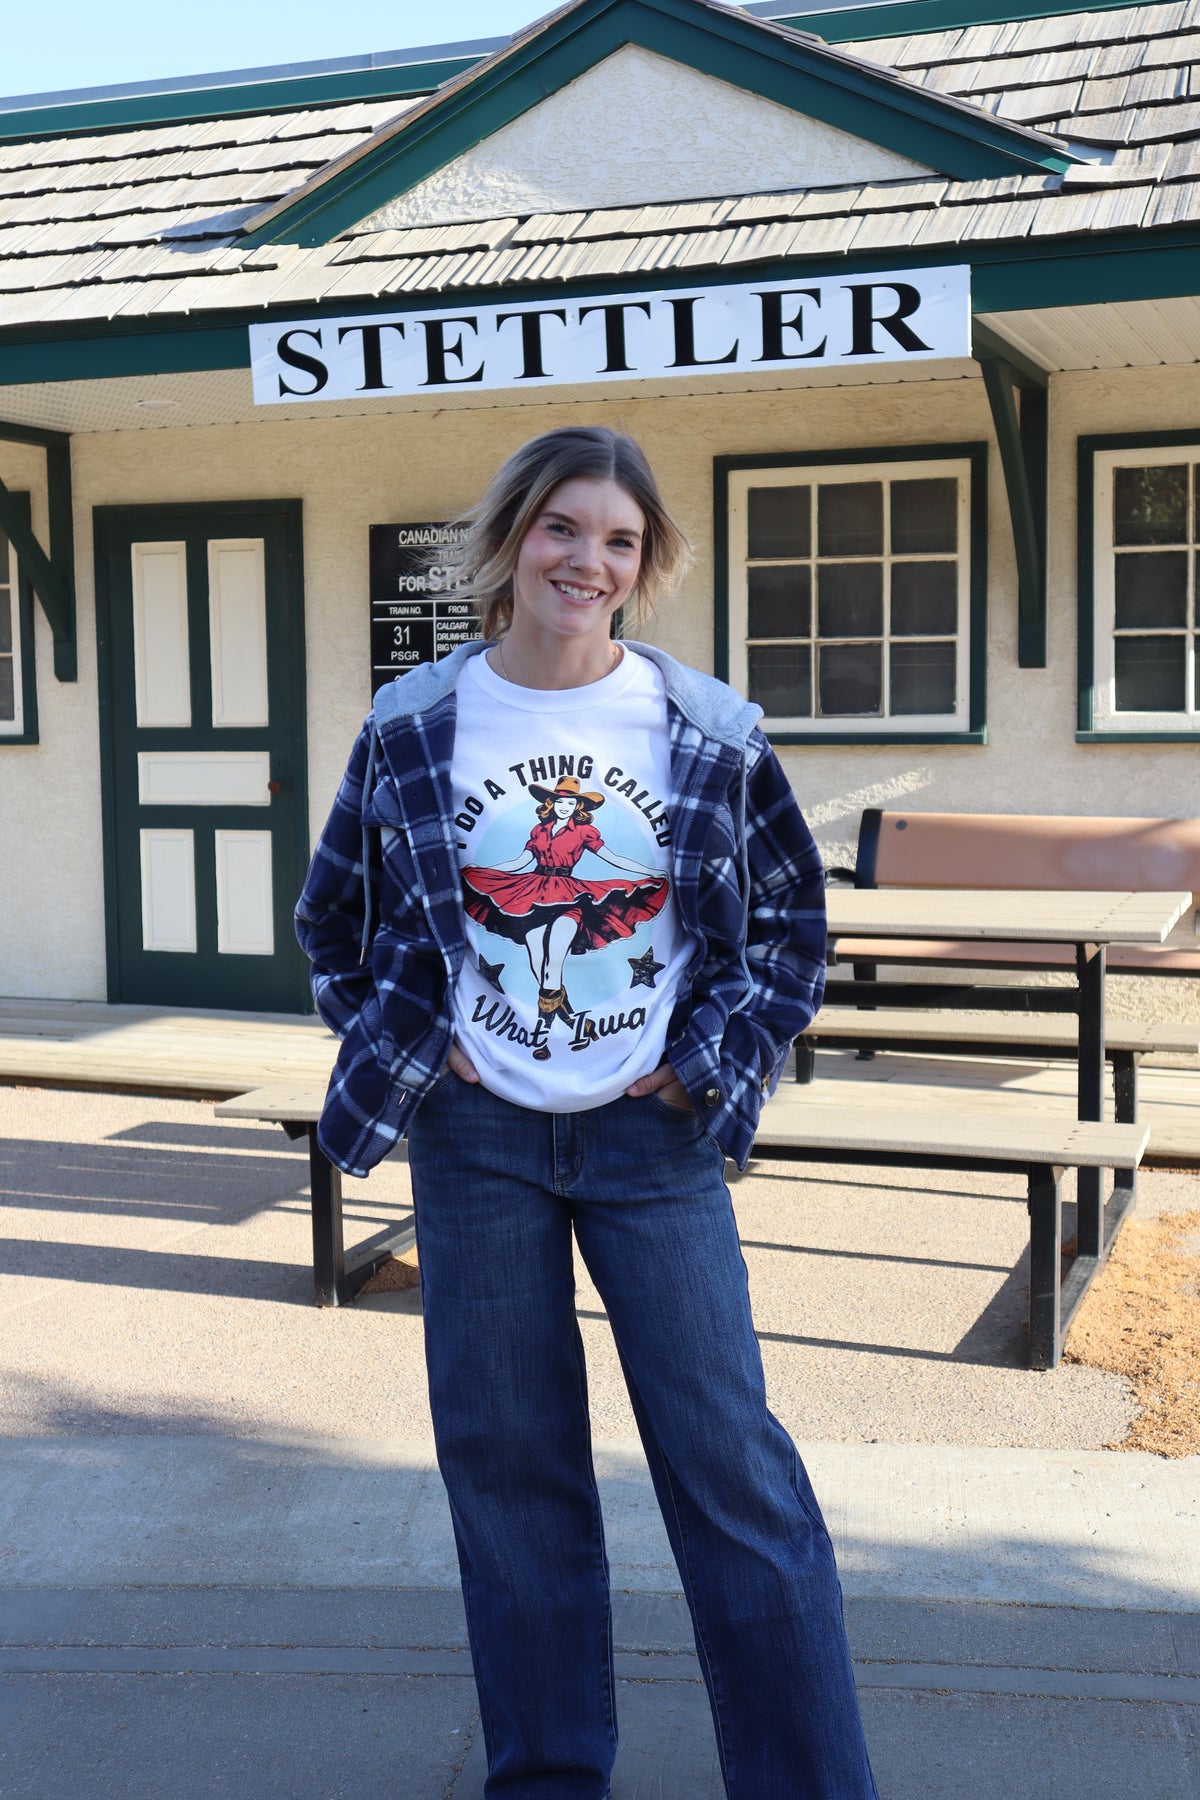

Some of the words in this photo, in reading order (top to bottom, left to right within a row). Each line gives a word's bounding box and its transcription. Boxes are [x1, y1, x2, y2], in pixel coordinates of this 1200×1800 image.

[276, 281, 935, 398] STETTLER
[398, 529, 458, 545] CANADIAN
[398, 575, 426, 592] FOR
[388, 606, 409, 615] TRAIN
[410, 606, 422, 615] NO.
[447, 605, 469, 614] FROM
[436, 621, 469, 630] CALGARY
[393, 625, 410, 645] 31
[436, 632, 484, 641] DRUMHELLER
[437, 643, 449, 652] BIG
[390, 651, 420, 661] PSGR
[454, 796, 484, 832] DO
[483, 778, 506, 800] A
[508, 754, 594, 787] THING
[603, 766, 672, 848] CALLED
[471, 994, 549, 1048] What
